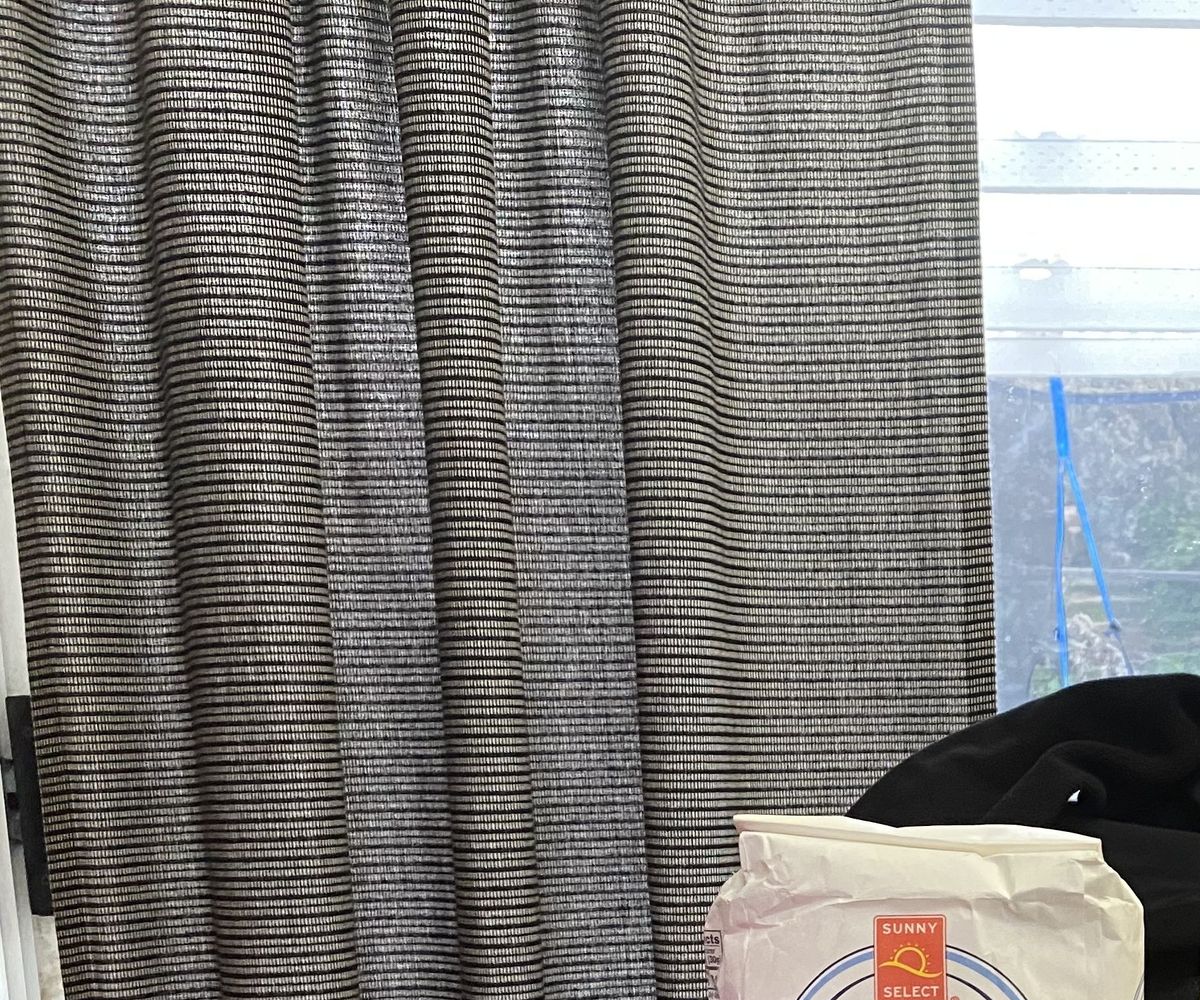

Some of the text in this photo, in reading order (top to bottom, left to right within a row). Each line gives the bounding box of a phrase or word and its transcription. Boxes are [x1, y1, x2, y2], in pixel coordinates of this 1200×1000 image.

[882, 922, 937, 934] SUNNY
[704, 933, 720, 945] cts
[883, 985, 939, 998] SELECT
